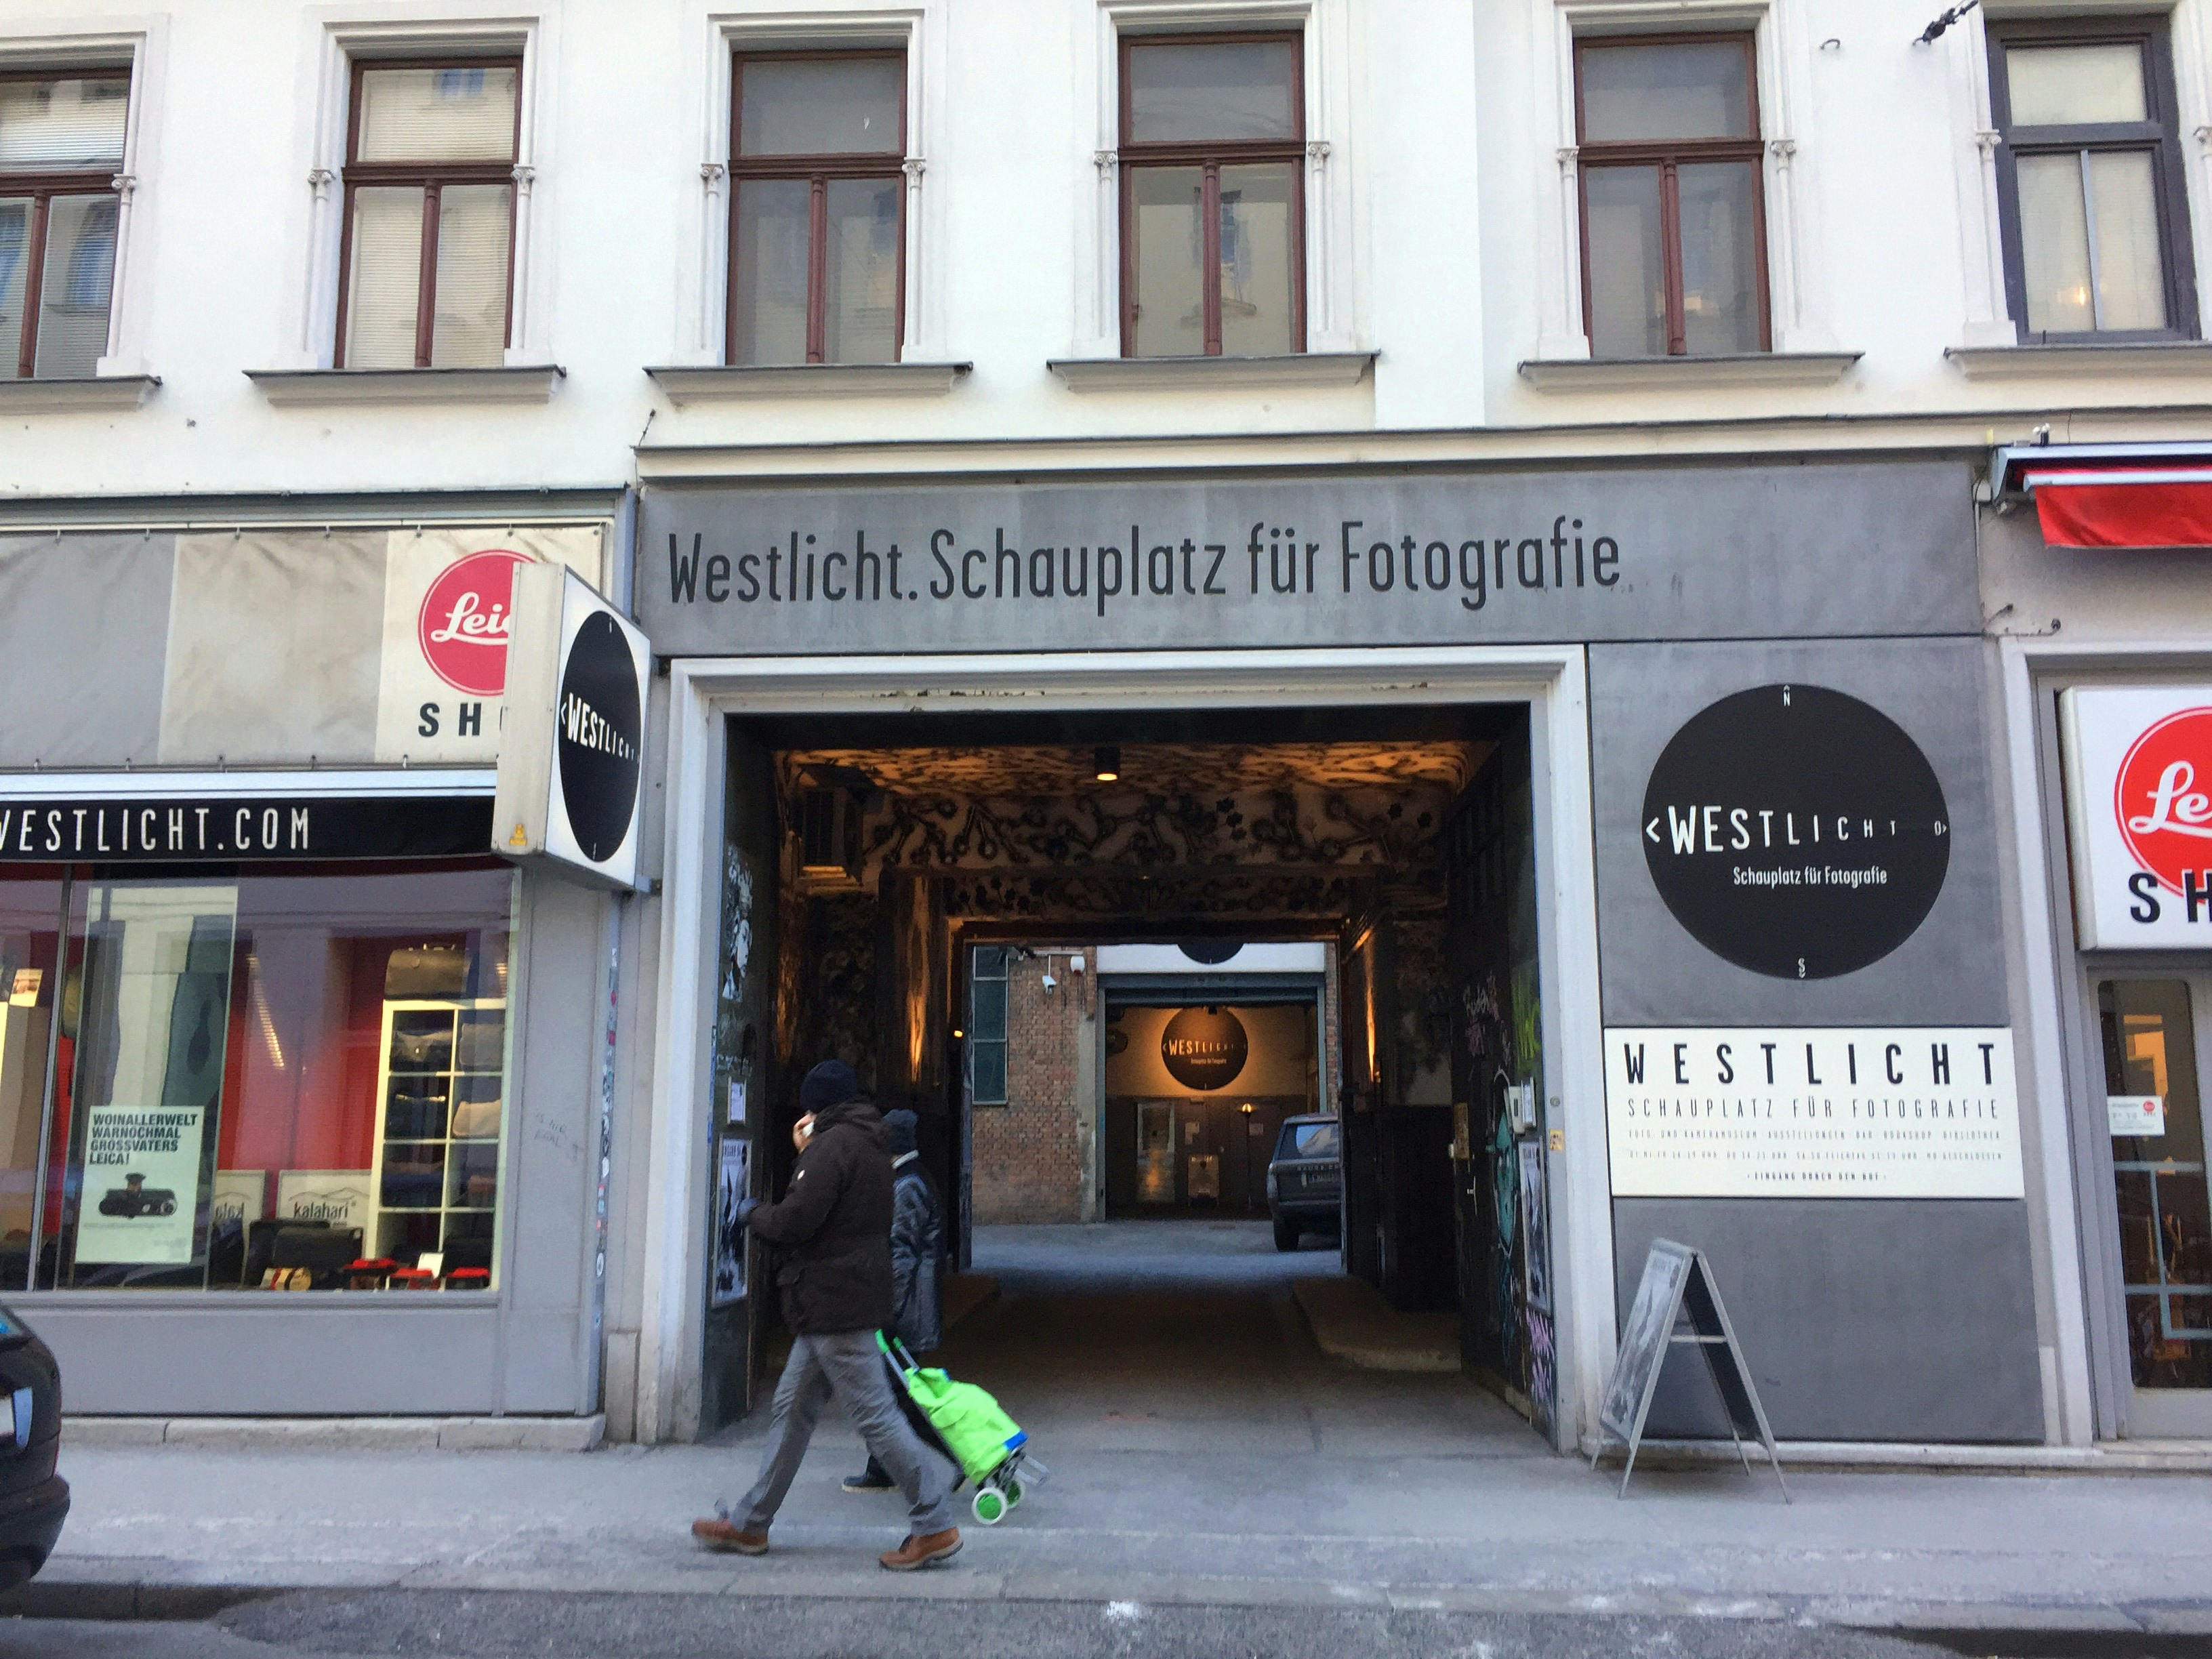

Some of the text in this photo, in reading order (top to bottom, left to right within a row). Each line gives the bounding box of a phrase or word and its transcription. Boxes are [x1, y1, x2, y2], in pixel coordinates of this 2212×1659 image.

[1247, 522, 1320, 594] für
[1342, 515, 1620, 611] Fotografie
[418, 702, 504, 737] SH
[1668, 805, 1896, 855] WESTLICHT
[1733, 865, 1887, 889] Schauplatz für Fotografie
[1624, 1042, 1994, 1085] WESTLICHT
[1628, 1095, 1998, 1118] SCHAUPLATZ FÜR FOTOGRAFIE
[293, 1201, 348, 1218] kalahari
